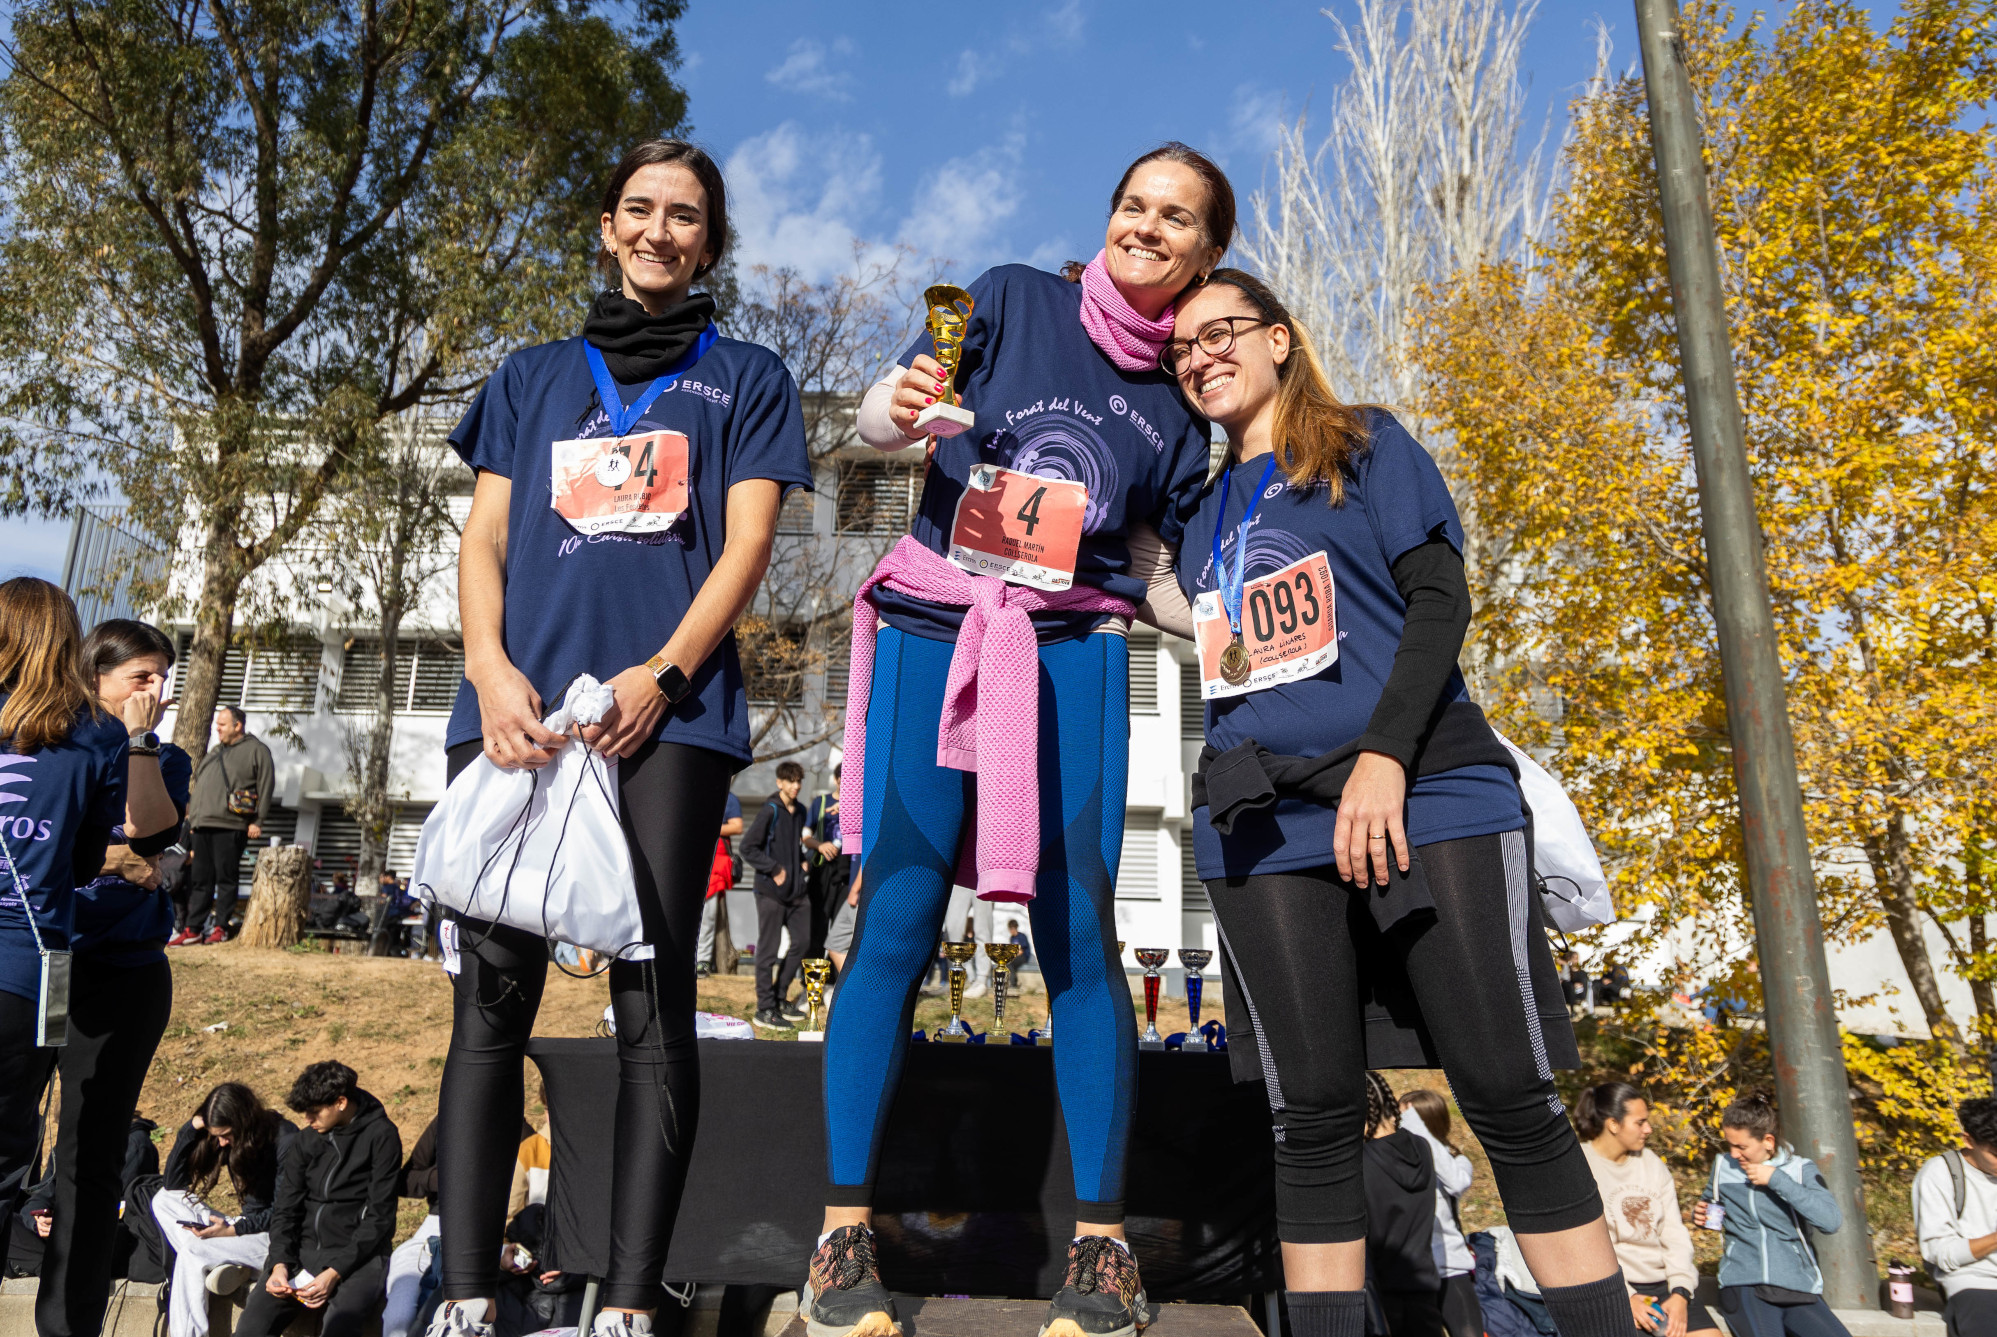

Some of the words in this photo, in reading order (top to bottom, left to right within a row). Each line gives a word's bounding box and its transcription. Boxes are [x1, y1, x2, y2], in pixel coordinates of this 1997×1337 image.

[682, 380, 731, 405] ERSCE
[1006, 400, 1044, 426] Forat
[1048, 397, 1070, 411] del
[1074, 400, 1103, 425] Vent
[1130, 409, 1165, 452] ERSCE
[613, 493, 632, 502] LAURA
[1016, 486, 1048, 536] 4
[1001, 536, 1022, 548] RAQUEL
[1023, 540, 1045, 554] MARTÍN
[1003, 547, 1038, 563] COLLSEROLA
[1317, 565, 1328, 583] 1093
[1323, 583, 1332, 603] ROBA
[1236, 571, 1320, 645] 093
